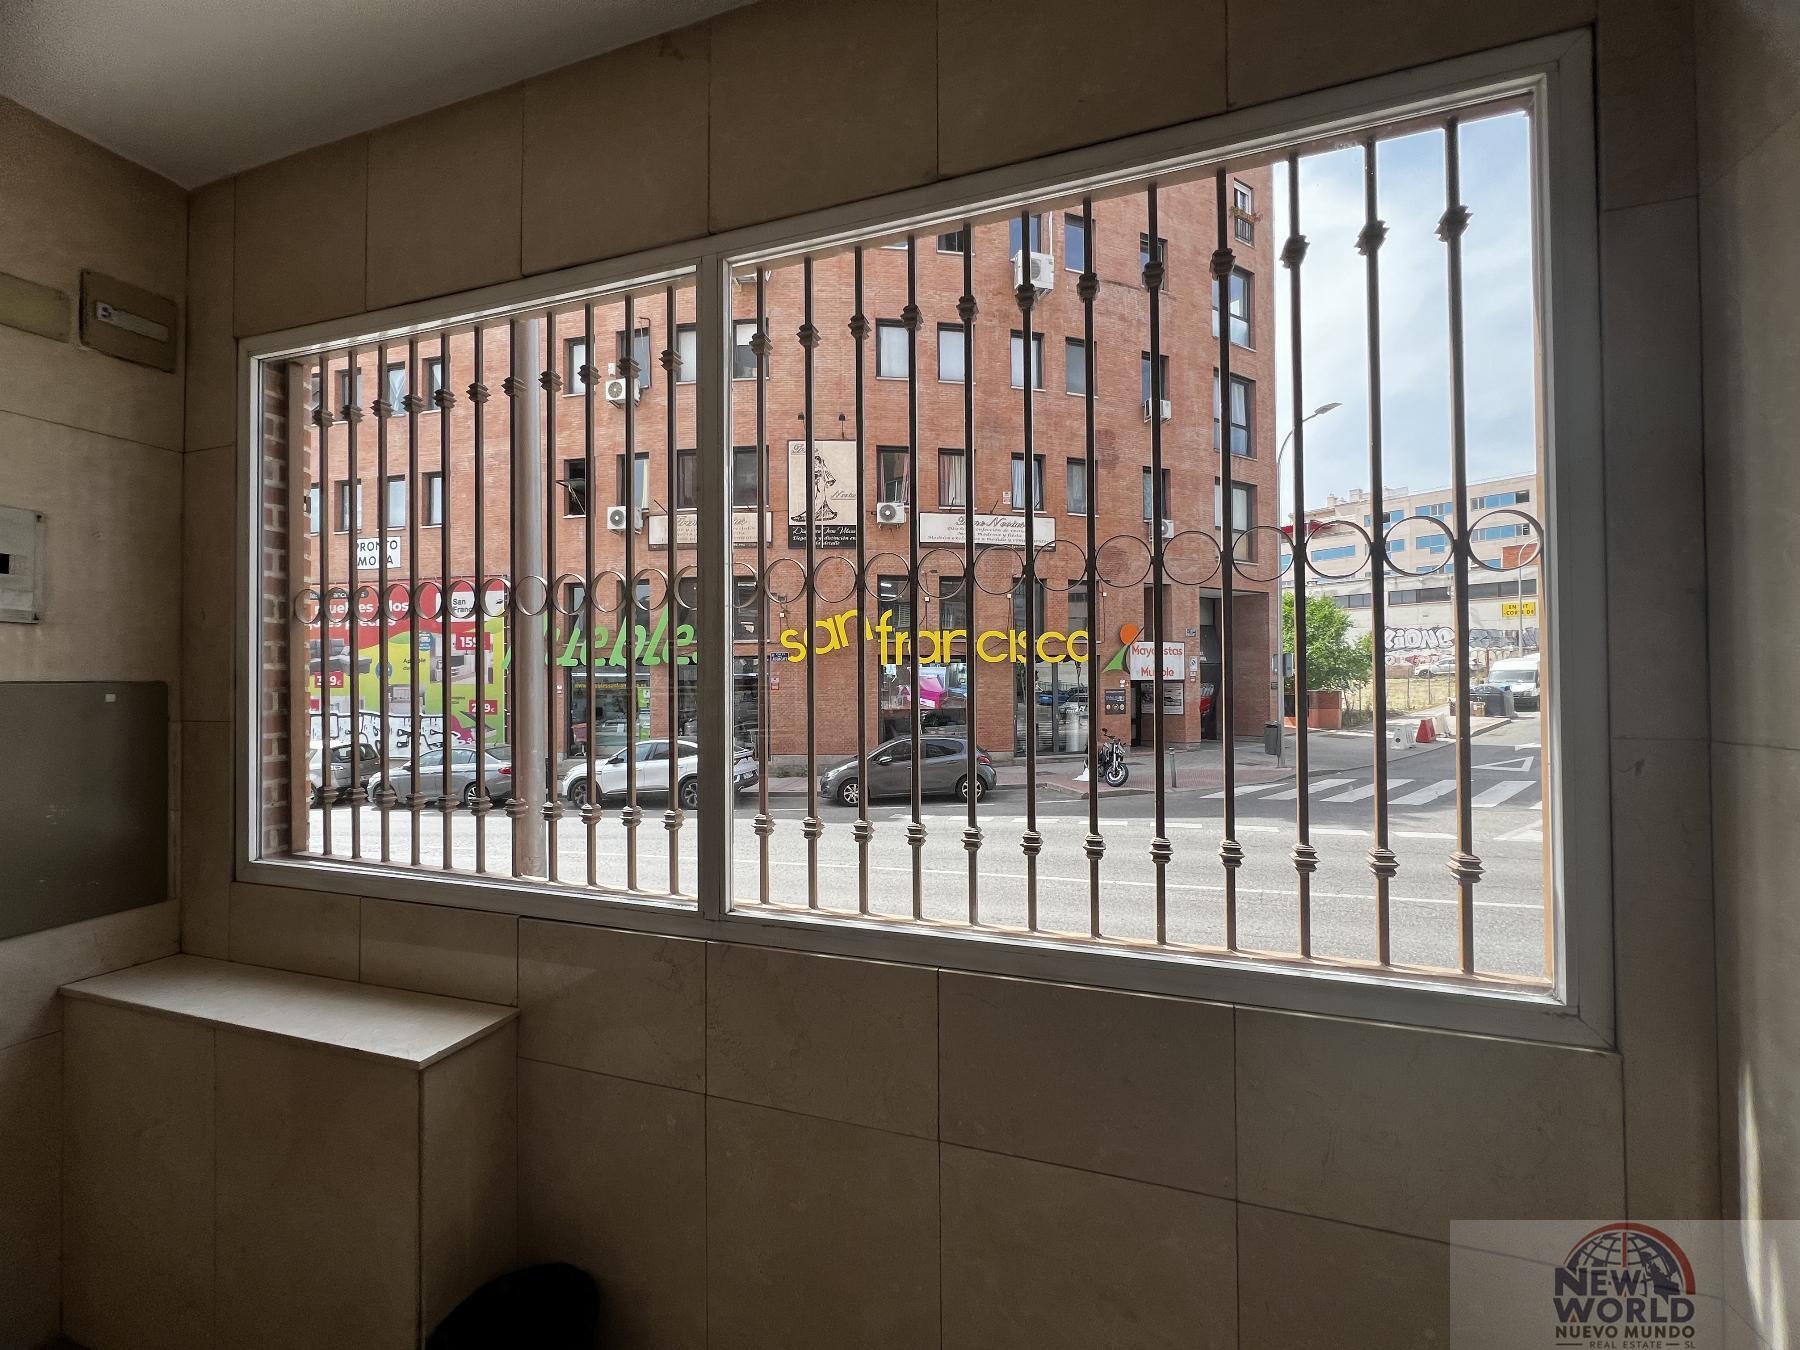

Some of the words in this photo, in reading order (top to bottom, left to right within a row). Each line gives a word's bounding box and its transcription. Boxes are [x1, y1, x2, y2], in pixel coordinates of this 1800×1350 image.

[358, 555, 394, 567] MOA
[780, 609, 873, 662] san
[876, 609, 1089, 665] francisco
[1132, 645, 1183, 657] Maystas
[471, 703, 496, 713] 29€
